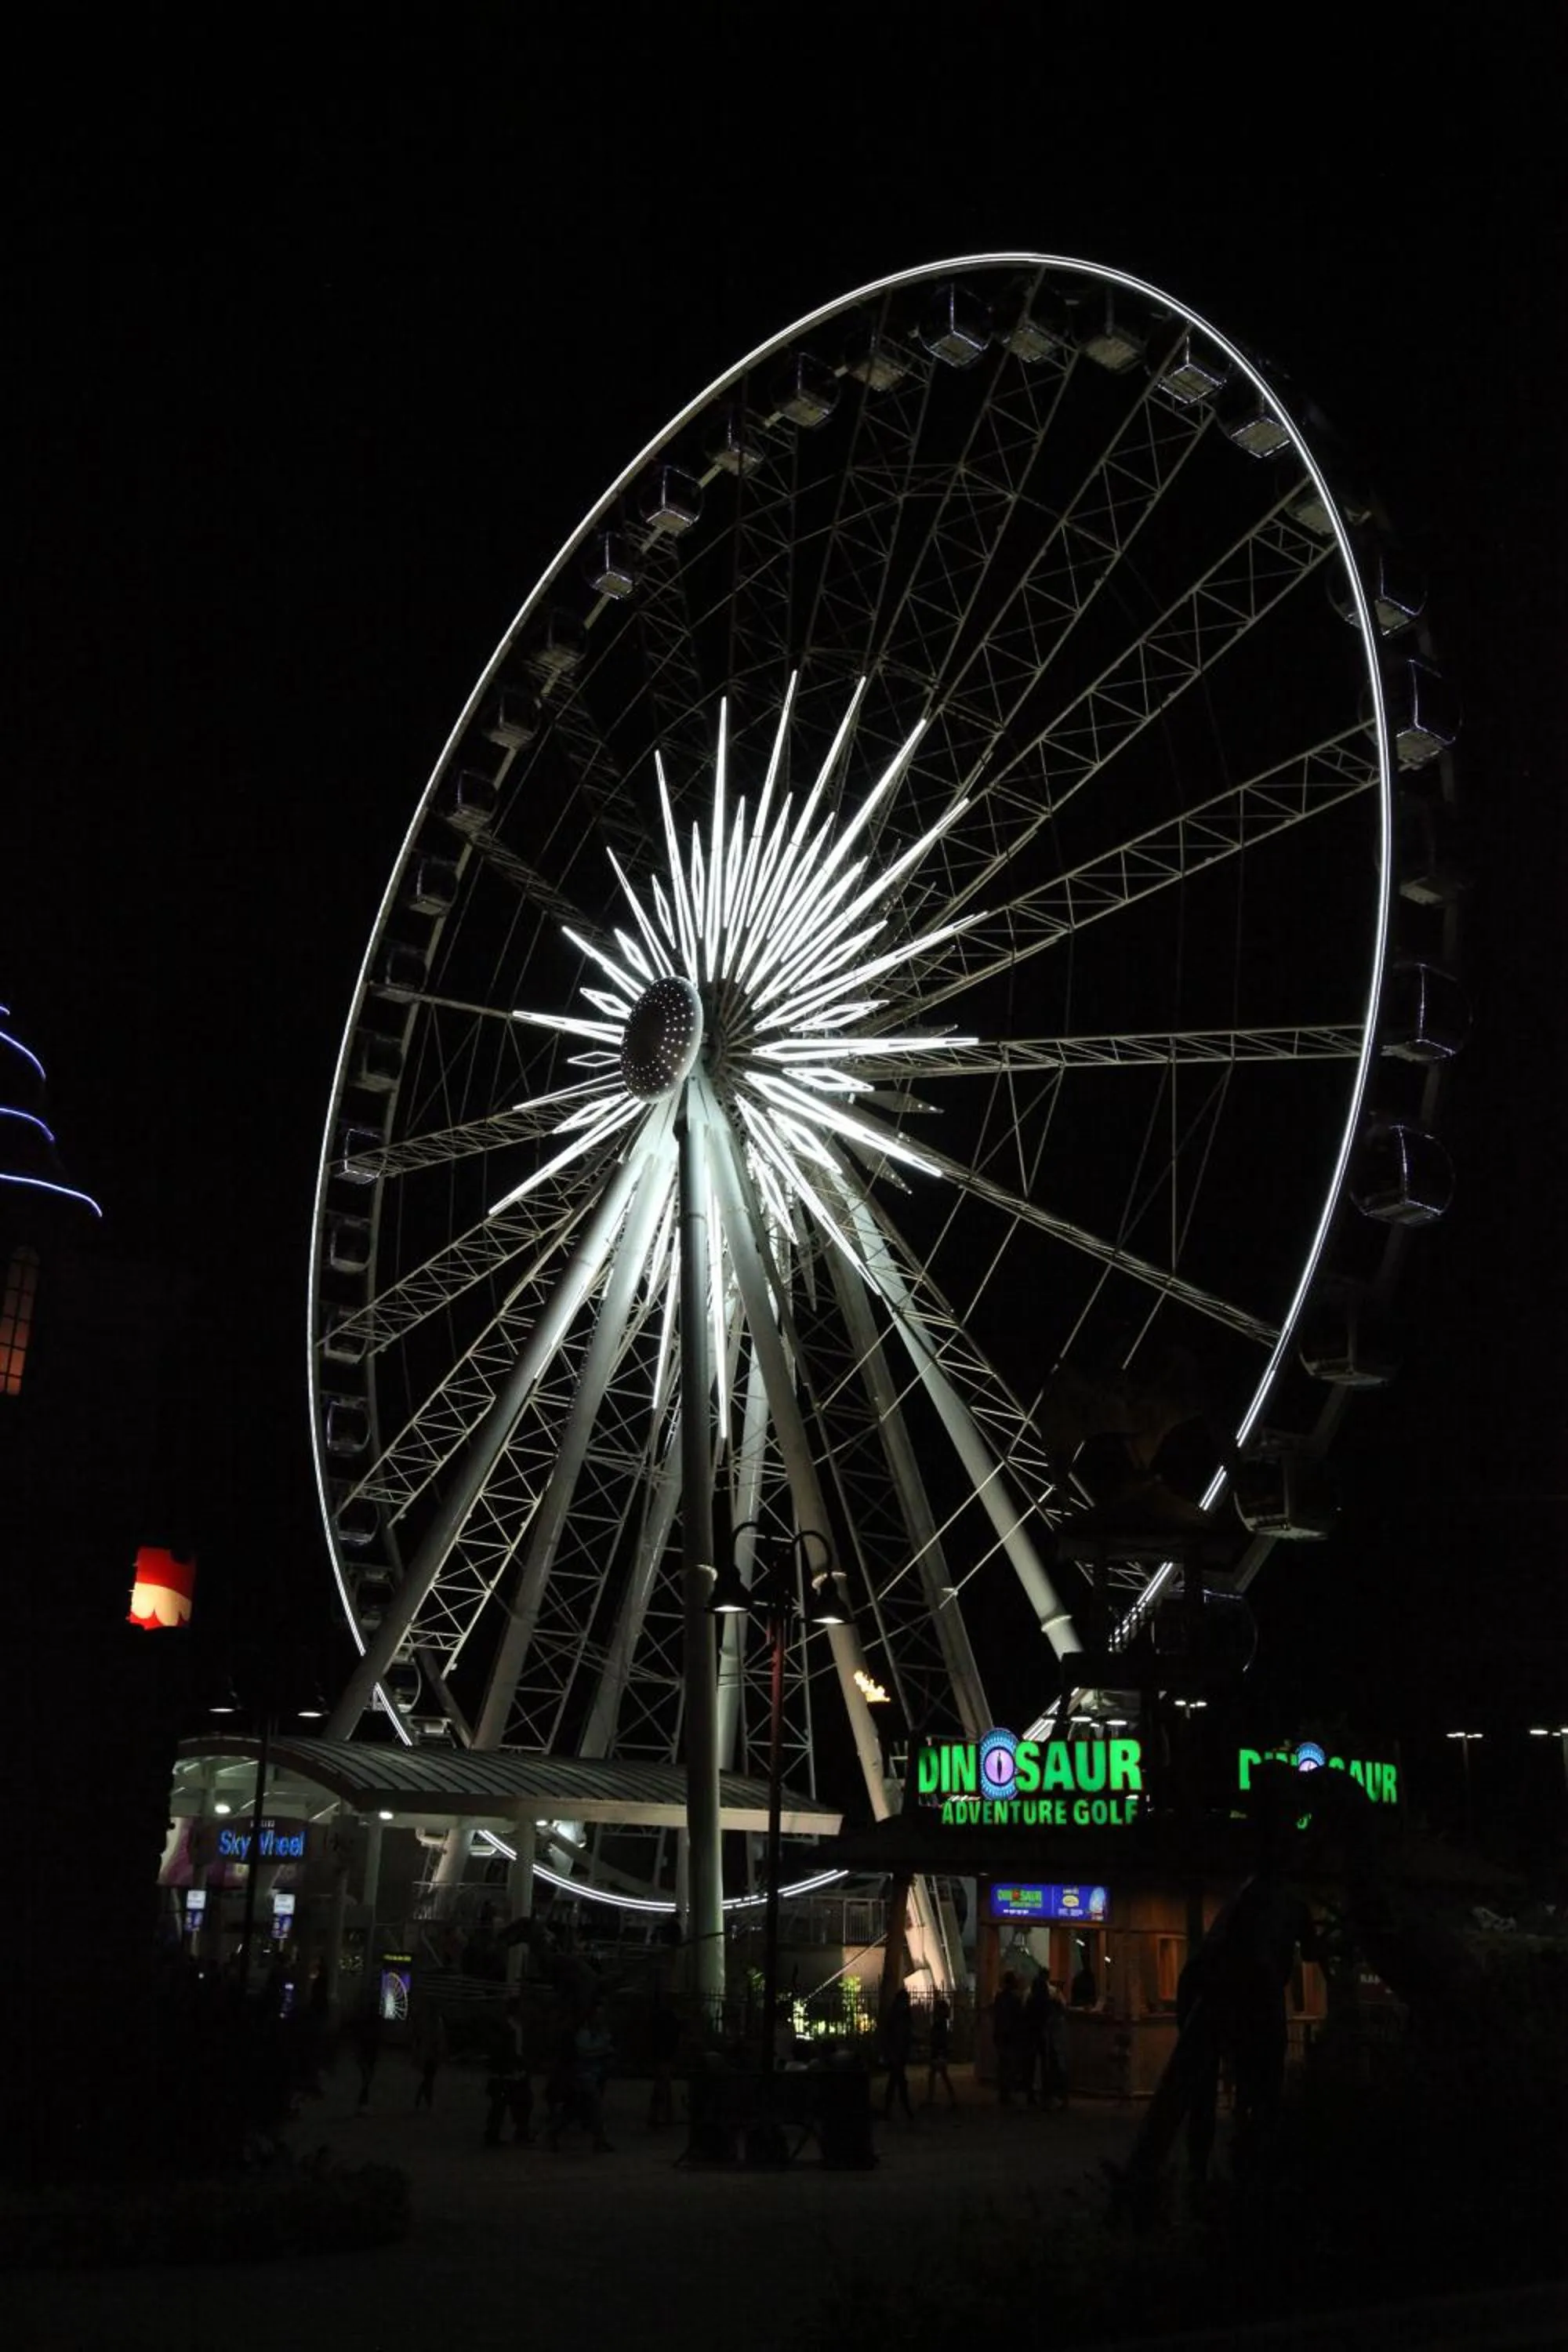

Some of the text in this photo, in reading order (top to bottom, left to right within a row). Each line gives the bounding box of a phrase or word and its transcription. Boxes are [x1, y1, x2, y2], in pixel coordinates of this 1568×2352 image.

[917, 1727, 1142, 1800] DINOSAUR
[941, 1798, 1138, 1825] ADVENTURE GOLF
